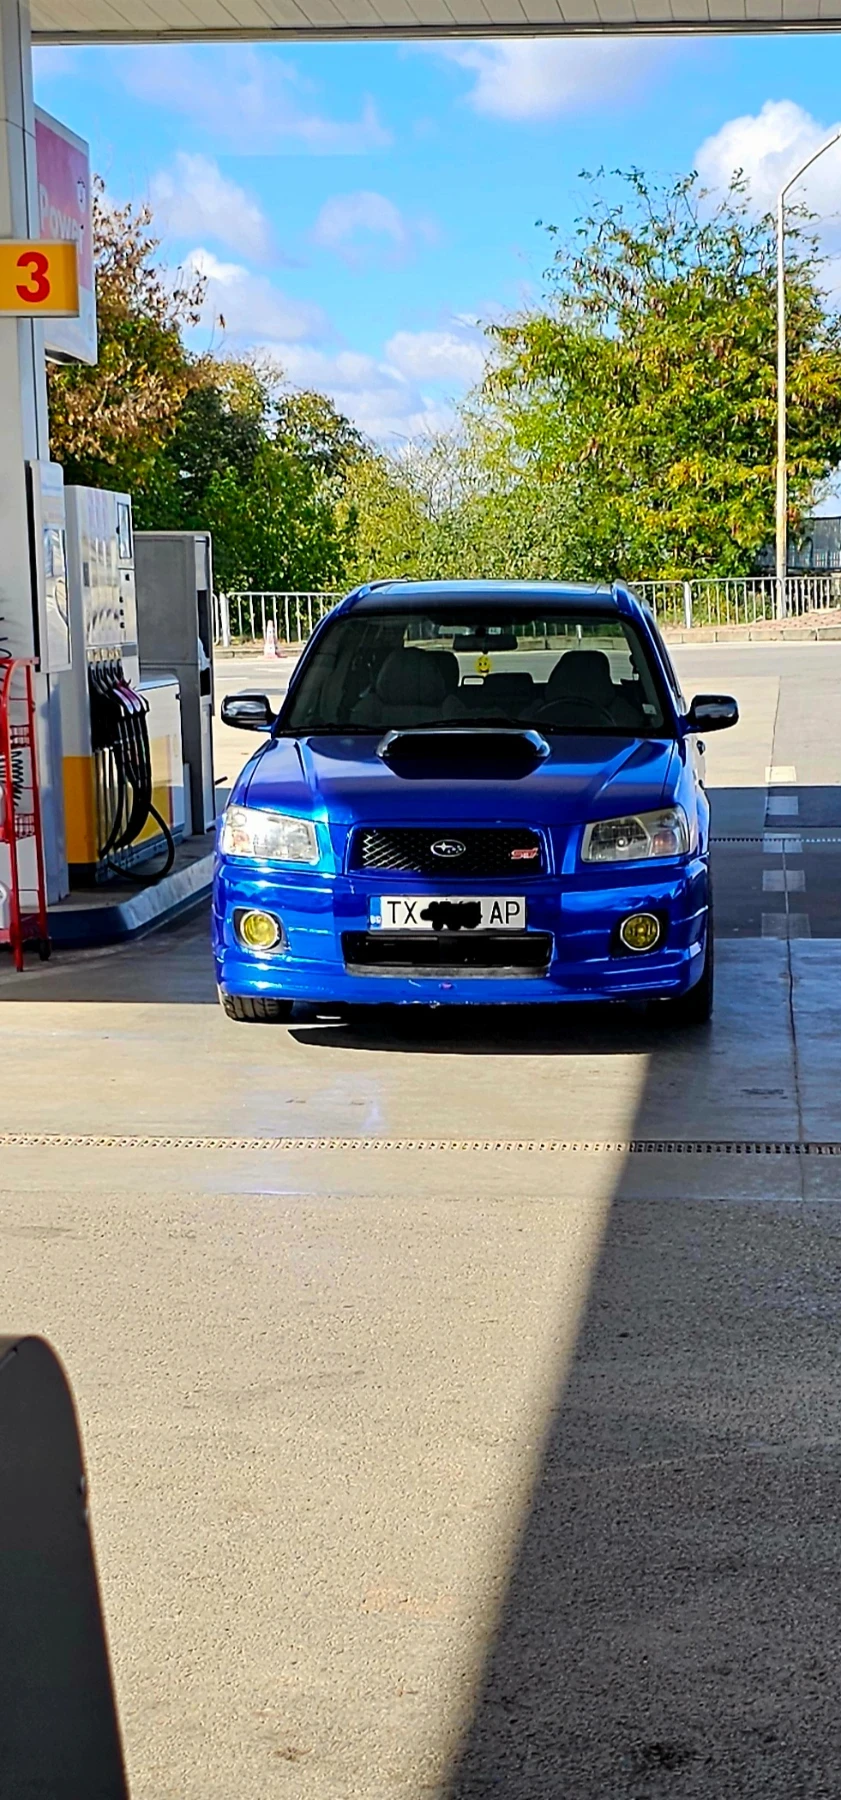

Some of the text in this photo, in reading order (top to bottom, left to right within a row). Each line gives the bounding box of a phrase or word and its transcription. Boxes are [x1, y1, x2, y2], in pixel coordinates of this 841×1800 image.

[16, 251, 51, 303] 3
[387, 901, 418, 925] TX
[489, 901, 520, 925] AP
